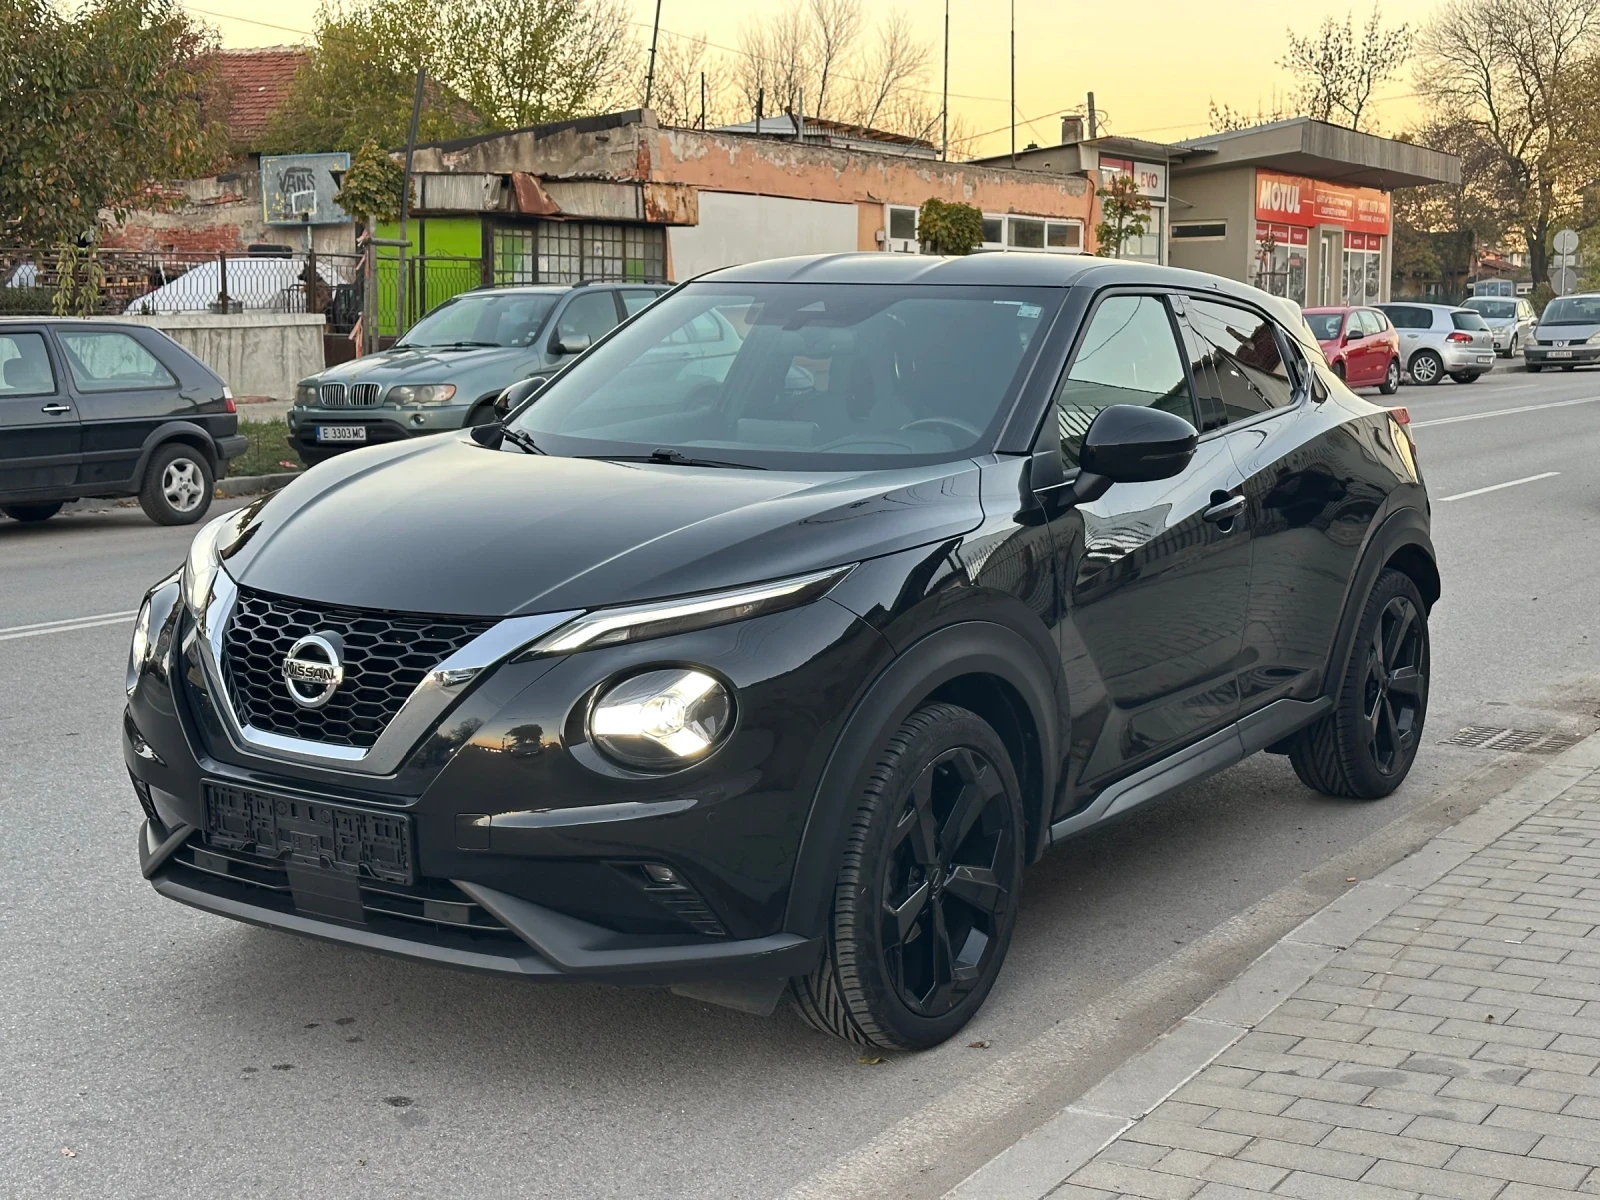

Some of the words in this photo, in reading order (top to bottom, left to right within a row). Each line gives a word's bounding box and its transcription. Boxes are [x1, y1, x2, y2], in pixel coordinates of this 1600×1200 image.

[276, 167, 315, 193] VANS
[1140, 171, 1158, 189] EVO
[1259, 180, 1300, 214] MOTUL
[323, 428, 329, 438] E
[286, 661, 334, 679] NISSAN
